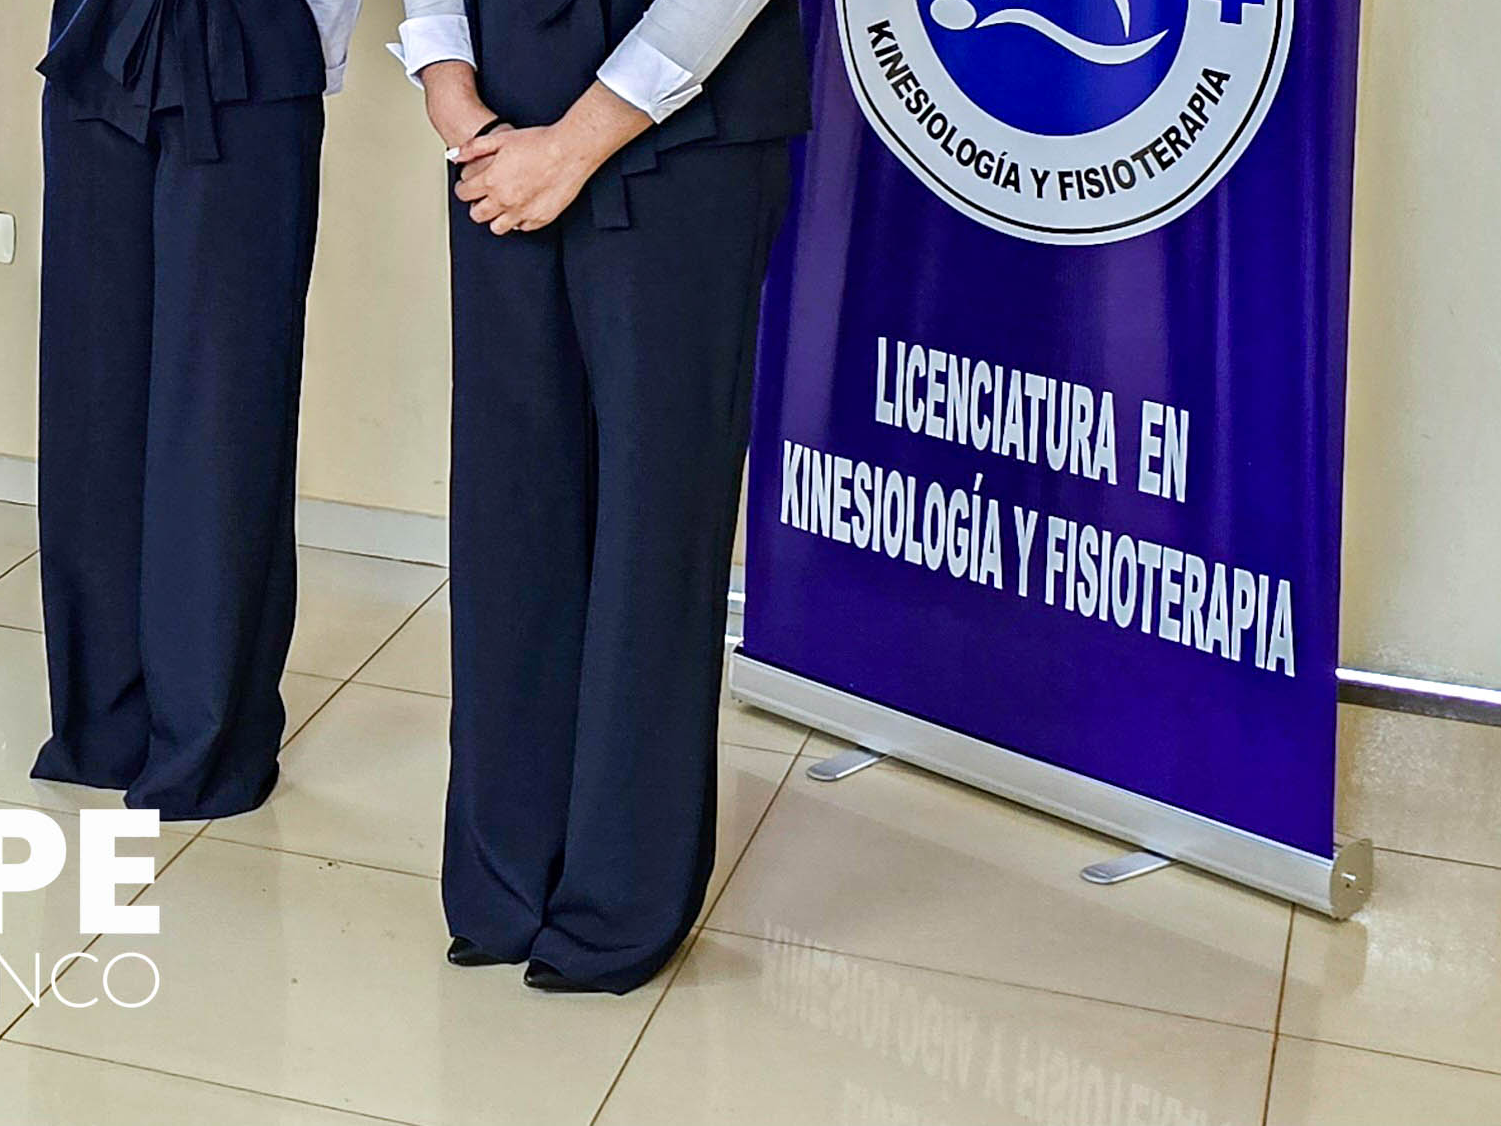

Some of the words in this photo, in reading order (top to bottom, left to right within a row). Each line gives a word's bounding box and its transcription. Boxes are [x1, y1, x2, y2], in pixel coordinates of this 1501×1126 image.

[866, 19, 1021, 194] KINESIOLOGÍA
[1030, 167, 1051, 199] Y
[1058, 67, 1232, 201] FISIOTERAPIA
[875, 336, 1118, 485] LICENCIATURA
[1138, 400, 1190, 503] EN
[780, 440, 1003, 590] KINESIOLOGÍA
[1014, 506, 1038, 598] Y
[1045, 515, 1296, 678] FISIOTERAPIA
